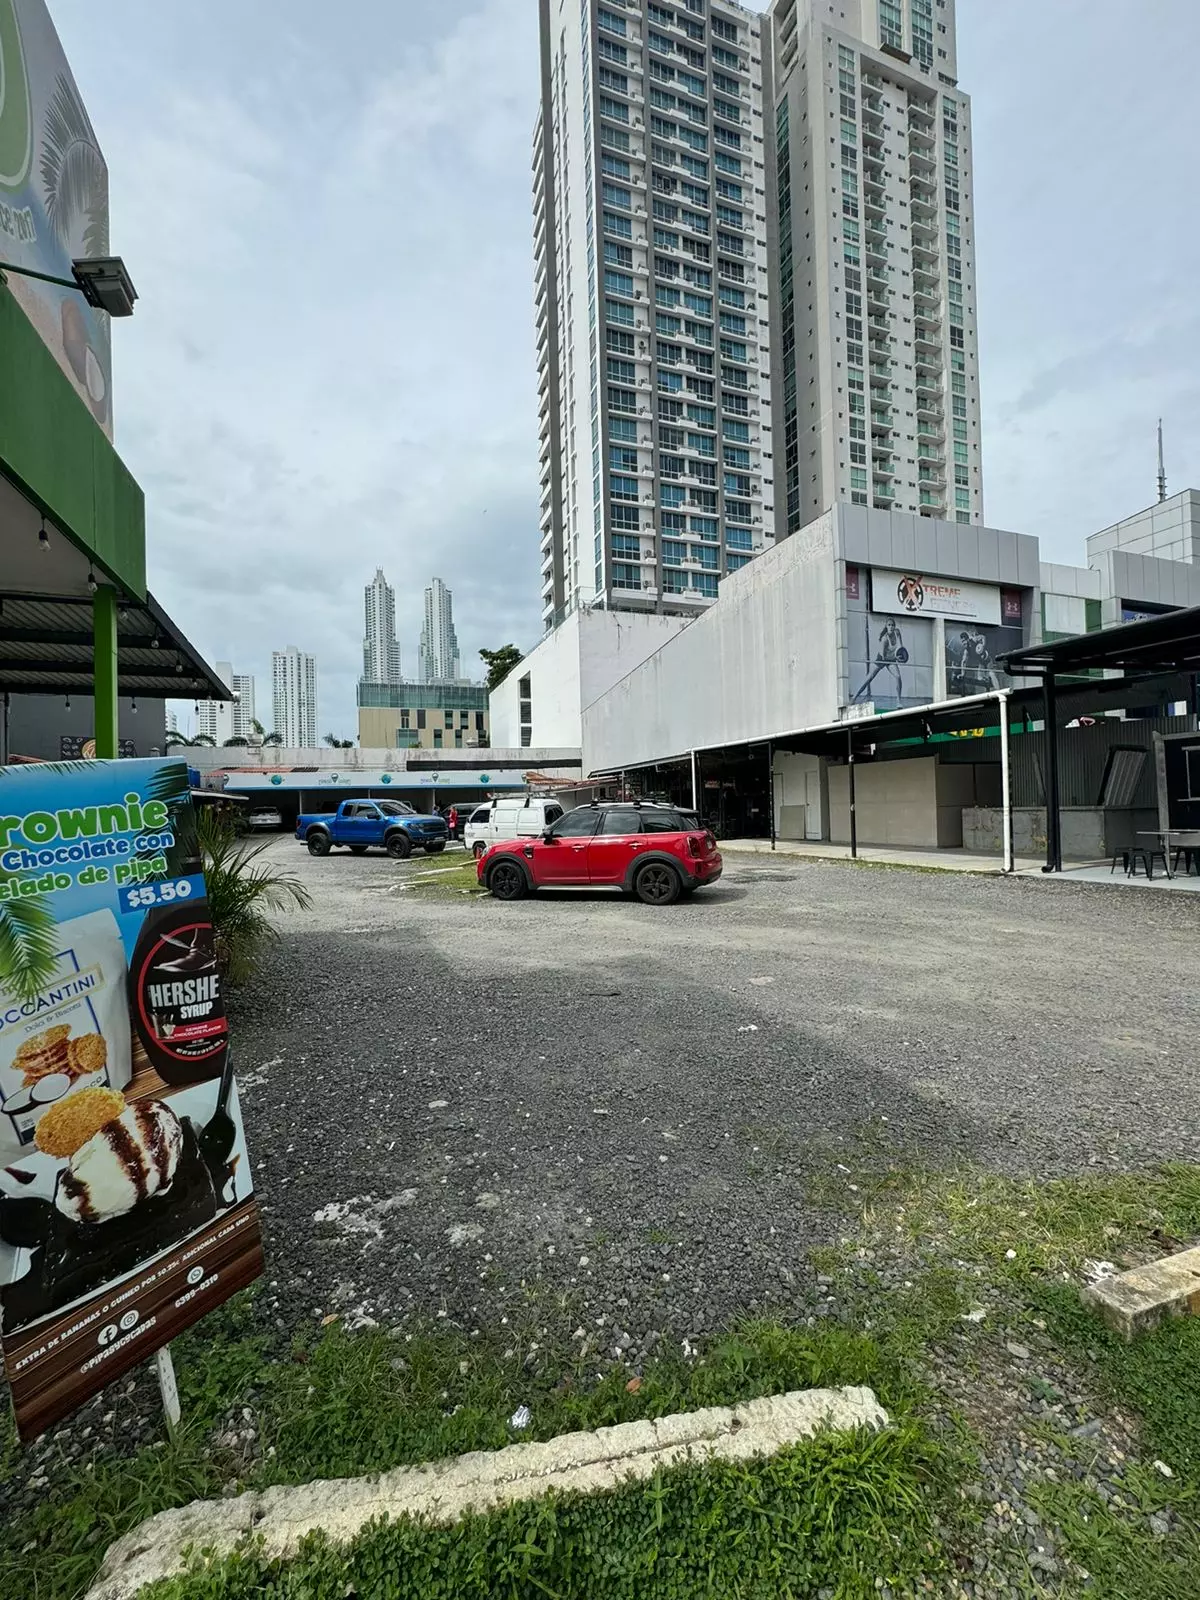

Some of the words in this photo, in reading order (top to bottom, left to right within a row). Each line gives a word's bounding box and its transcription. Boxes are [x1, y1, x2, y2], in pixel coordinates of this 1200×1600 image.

[2, 840, 130, 871] Chocolate
[135, 832, 175, 852] con
[0, 872, 72, 902] elado
[78, 865, 110, 885] de
[114, 856, 168, 885] pipa
[126, 880, 192, 908] $5.50
[0, 974, 95, 1030] CCANTINI
[180, 1001, 213, 1019] SYRUP
[16, 1346, 47, 1369] EXTRA
[47, 1337, 60, 1350] DE
[60, 1309, 101, 1340] BANANAS
[102, 1305, 109, 1313] O
[110, 1285, 140, 1308] GUINEO
[141, 1274, 156, 1288] POR
[182, 1236, 217, 1261] ADICIONAL
[218, 1224, 235, 1238] CADA
[236, 1214, 250, 1226] UNO
